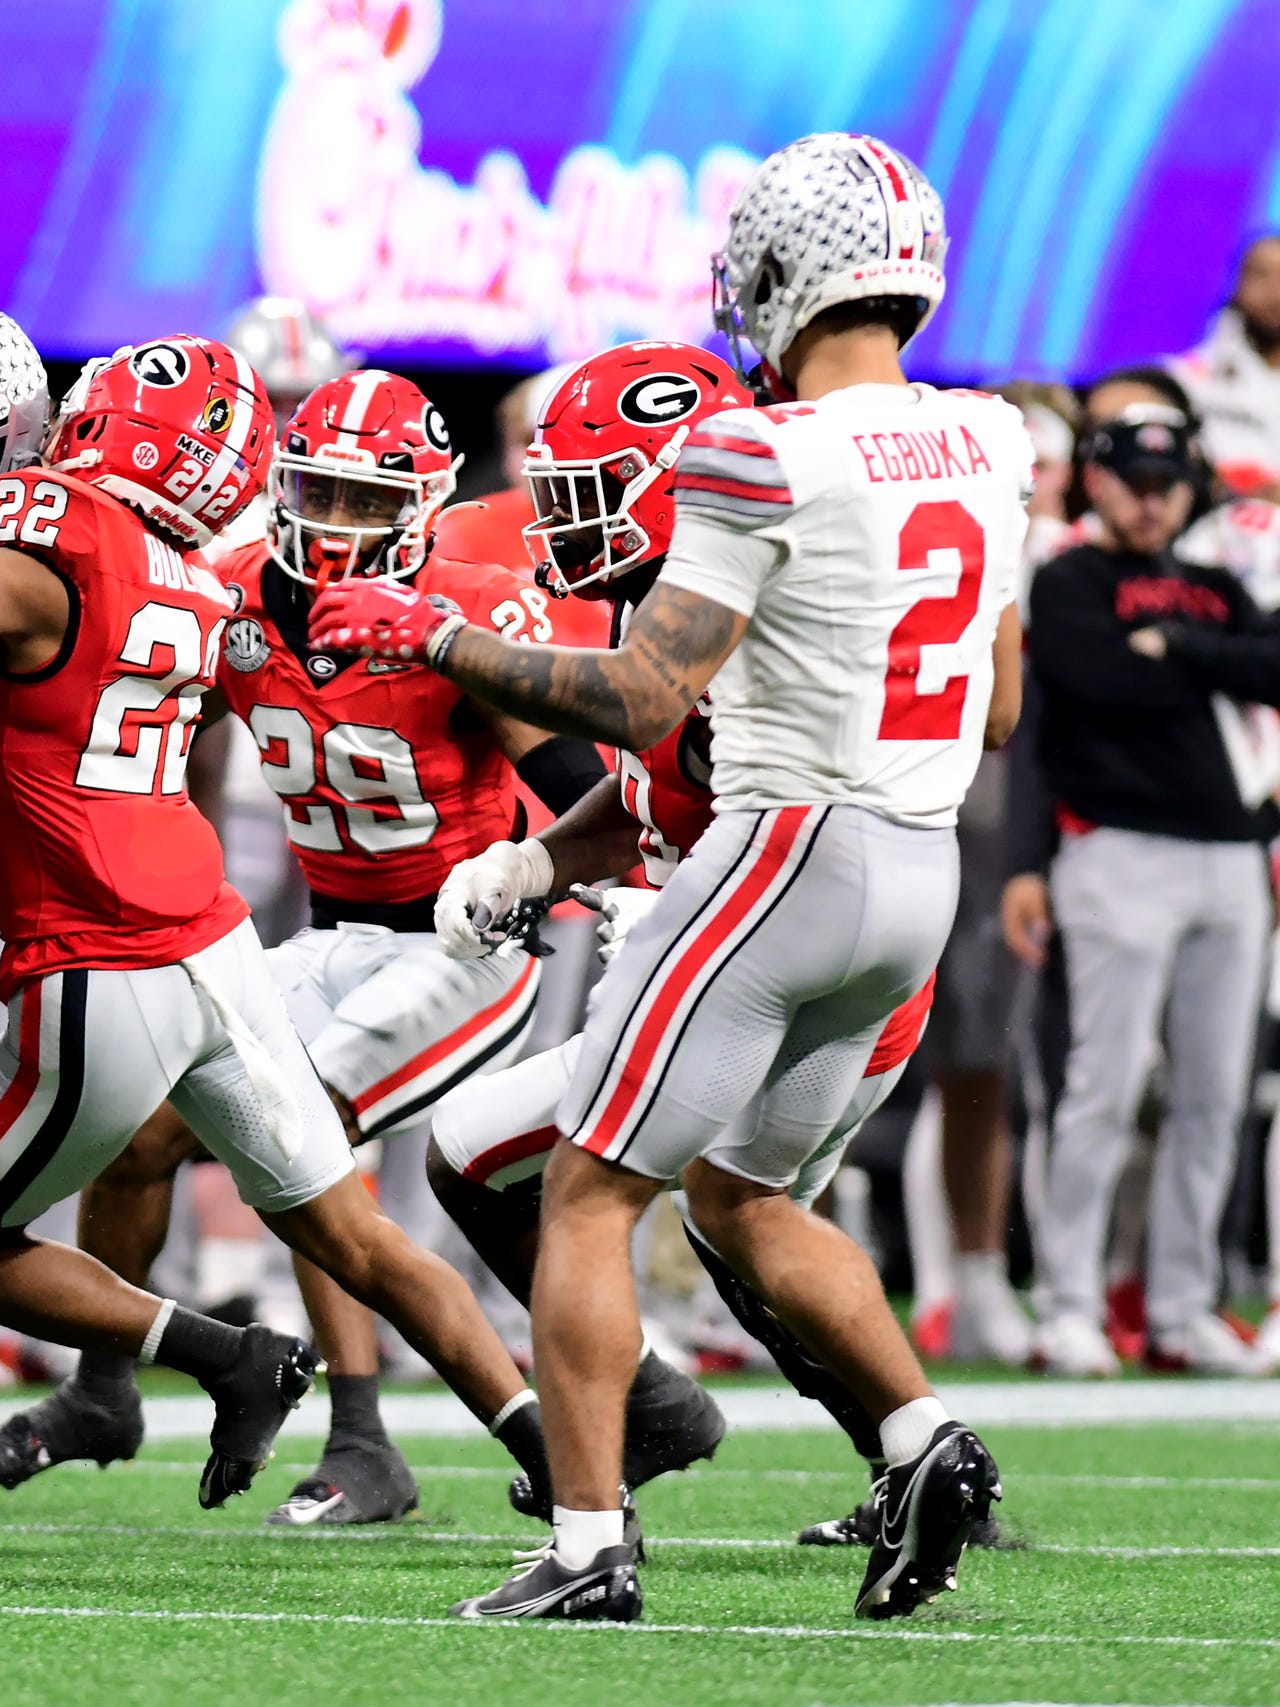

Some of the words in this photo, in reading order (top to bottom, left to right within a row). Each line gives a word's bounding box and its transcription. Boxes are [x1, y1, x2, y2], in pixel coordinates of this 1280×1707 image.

[131, 343, 188, 388] G
[621, 374, 699, 425] G
[135, 445, 156, 466] SEC
[852, 425, 992, 482] EGBUKA
[229, 619, 262, 658] SEC
[489, 587, 553, 644] 29
[877, 500, 984, 741] 2
[308, 657, 336, 676] G
[248, 703, 441, 854] 29
